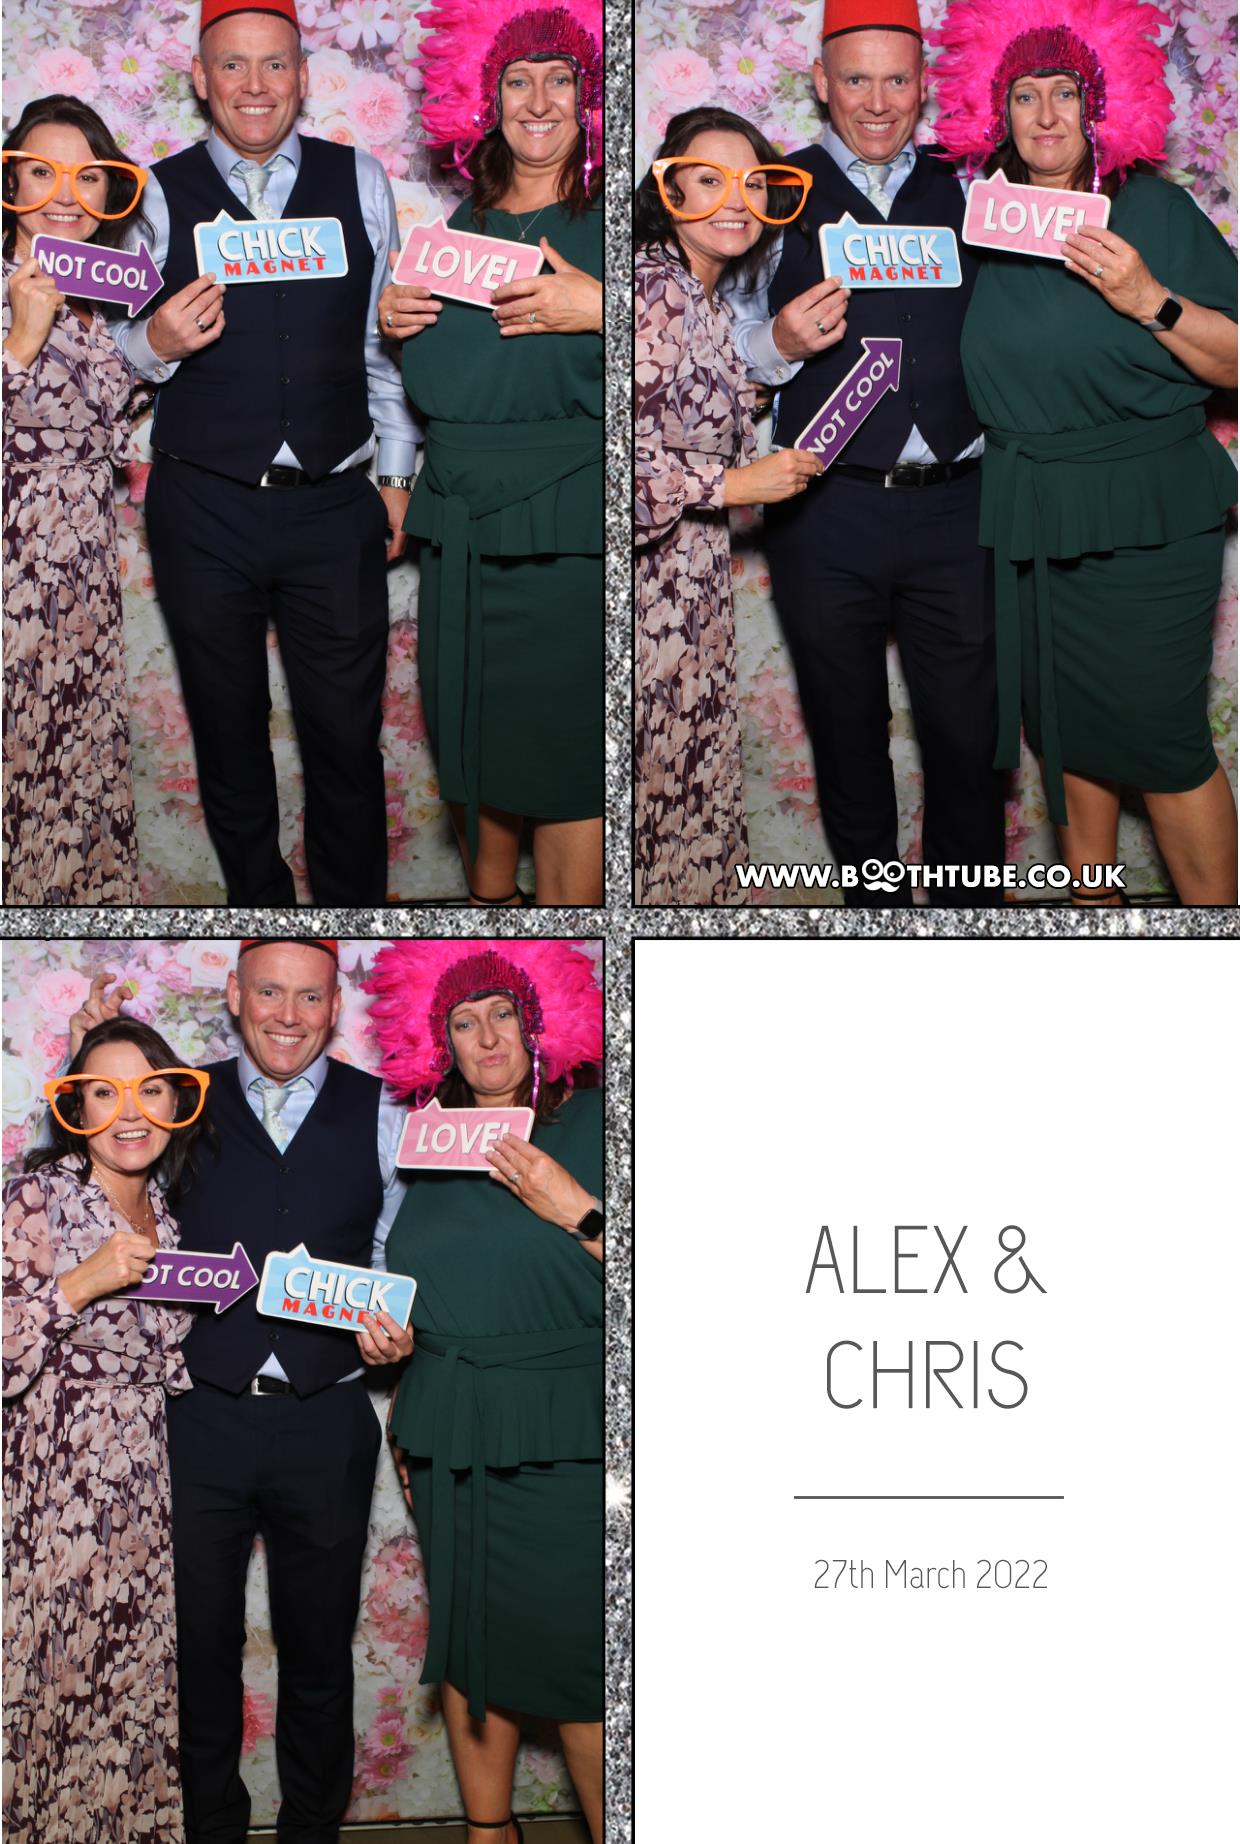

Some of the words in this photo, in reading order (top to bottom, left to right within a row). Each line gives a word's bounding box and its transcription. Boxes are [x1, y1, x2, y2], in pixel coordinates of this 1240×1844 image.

[217, 225, 326, 261] CHICK
[843, 233, 943, 266] CHICK
[38, 249, 86, 280] NOT
[91, 260, 149, 291] COOL
[223, 257, 326, 276] MAGNET
[414, 240, 518, 290] LOVE!
[848, 266, 943, 281] MAGNET
[806, 408, 846, 454] NOT
[845, 352, 894, 412] COOL
[177, 1266, 240, 1290] COOL
[284, 1266, 395, 1313] CHICK
